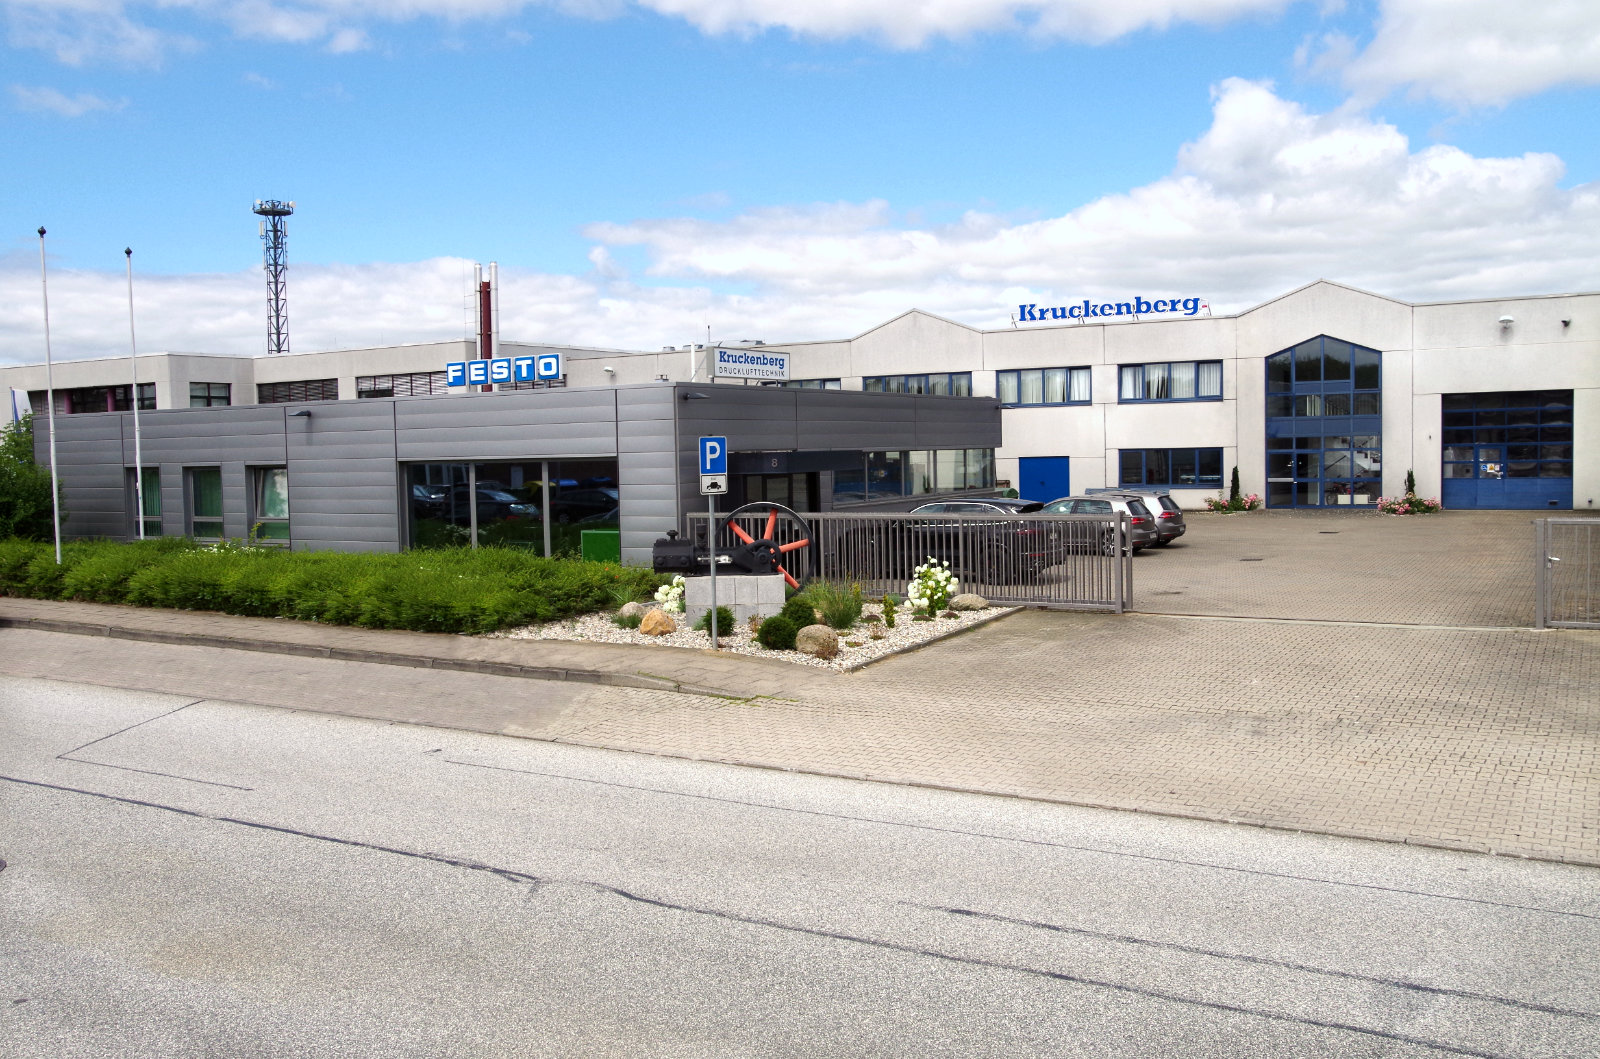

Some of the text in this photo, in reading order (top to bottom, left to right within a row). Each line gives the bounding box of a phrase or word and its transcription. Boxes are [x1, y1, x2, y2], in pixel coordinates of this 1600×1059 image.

[1019, 297, 1200, 321] Kruckenberg
[447, 357, 558, 383] FESTO
[719, 351, 785, 369] Kruckenberg
[719, 366, 785, 377] DRUCKLUFTTECHNIK
[706, 441, 721, 470] P
[771, 458, 778, 468] 8
